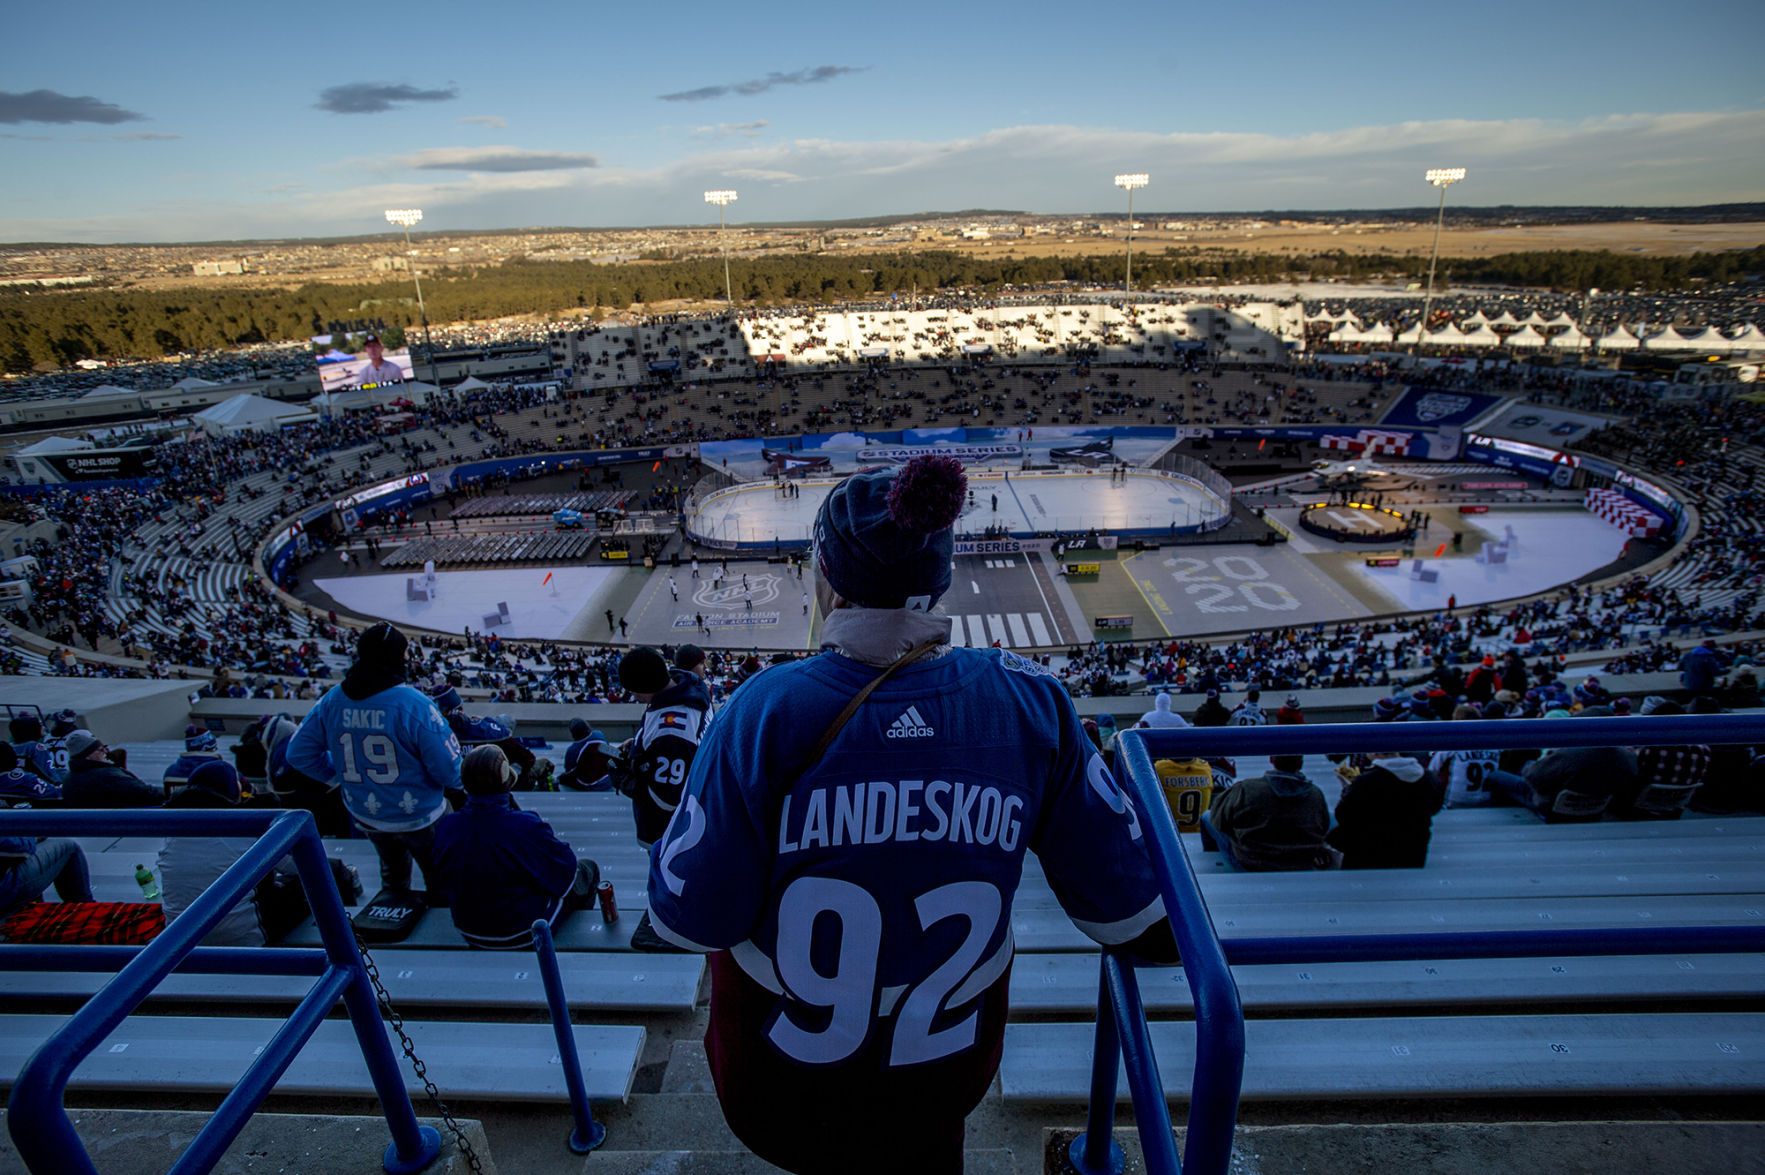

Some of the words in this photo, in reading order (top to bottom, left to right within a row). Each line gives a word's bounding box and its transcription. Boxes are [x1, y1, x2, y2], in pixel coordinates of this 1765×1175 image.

[78, 459, 97, 467] NHL
[98, 457, 121, 466] SHOP
[976, 541, 1020, 552] SERIES
[1163, 556, 1271, 583] 20
[1185, 581, 1302, 614] 20
[342, 708, 386, 729] SAKIC
[887, 725, 934, 738] adidas
[340, 733, 399, 784] 19
[654, 756, 686, 785] 29
[779, 780, 1023, 854] LANDESKOG
[1177, 789, 1203, 827] 9
[368, 906, 413, 919] TRULY
[768, 876, 1003, 1067] 92
[1550, 1043, 1570, 1054] 30
